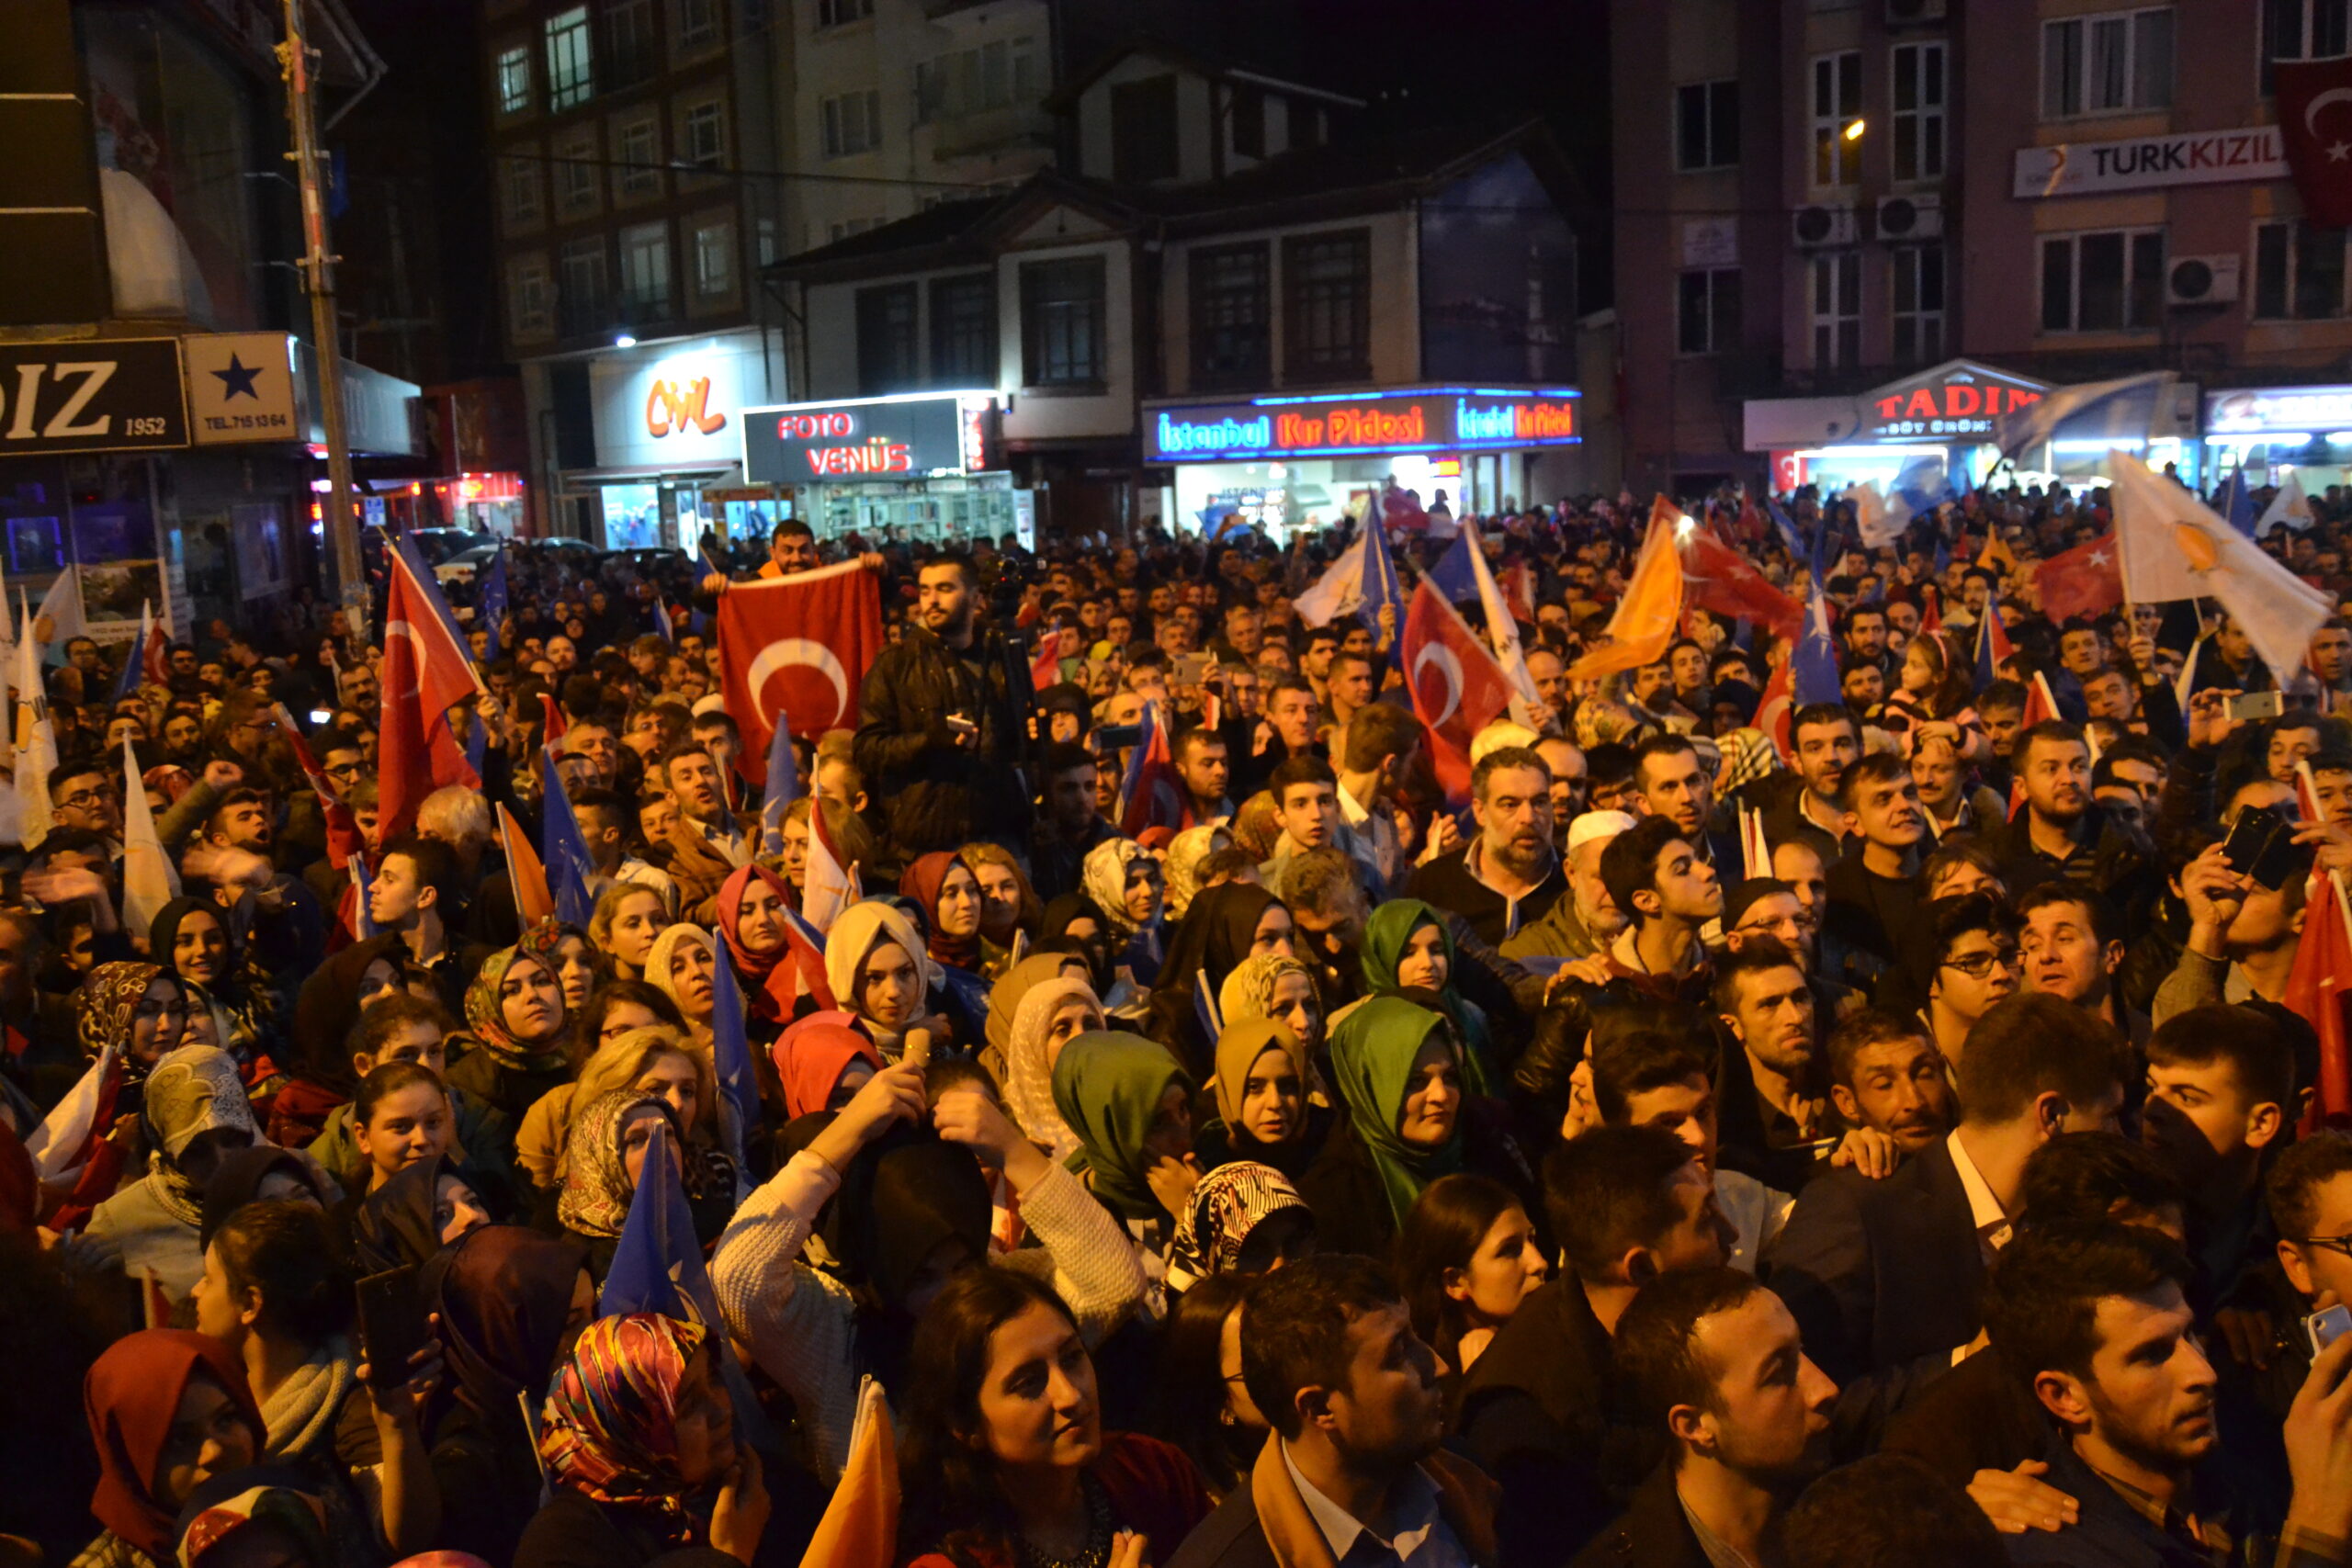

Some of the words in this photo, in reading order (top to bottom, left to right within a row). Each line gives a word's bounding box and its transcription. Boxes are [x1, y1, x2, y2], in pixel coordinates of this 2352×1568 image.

[0, 361, 118, 439] IZ
[126, 418, 166, 435] 1952
[777, 412, 854, 439] FOTO
[1329, 405, 1424, 446] Pidesi
[806, 436, 912, 475] VENÜS
